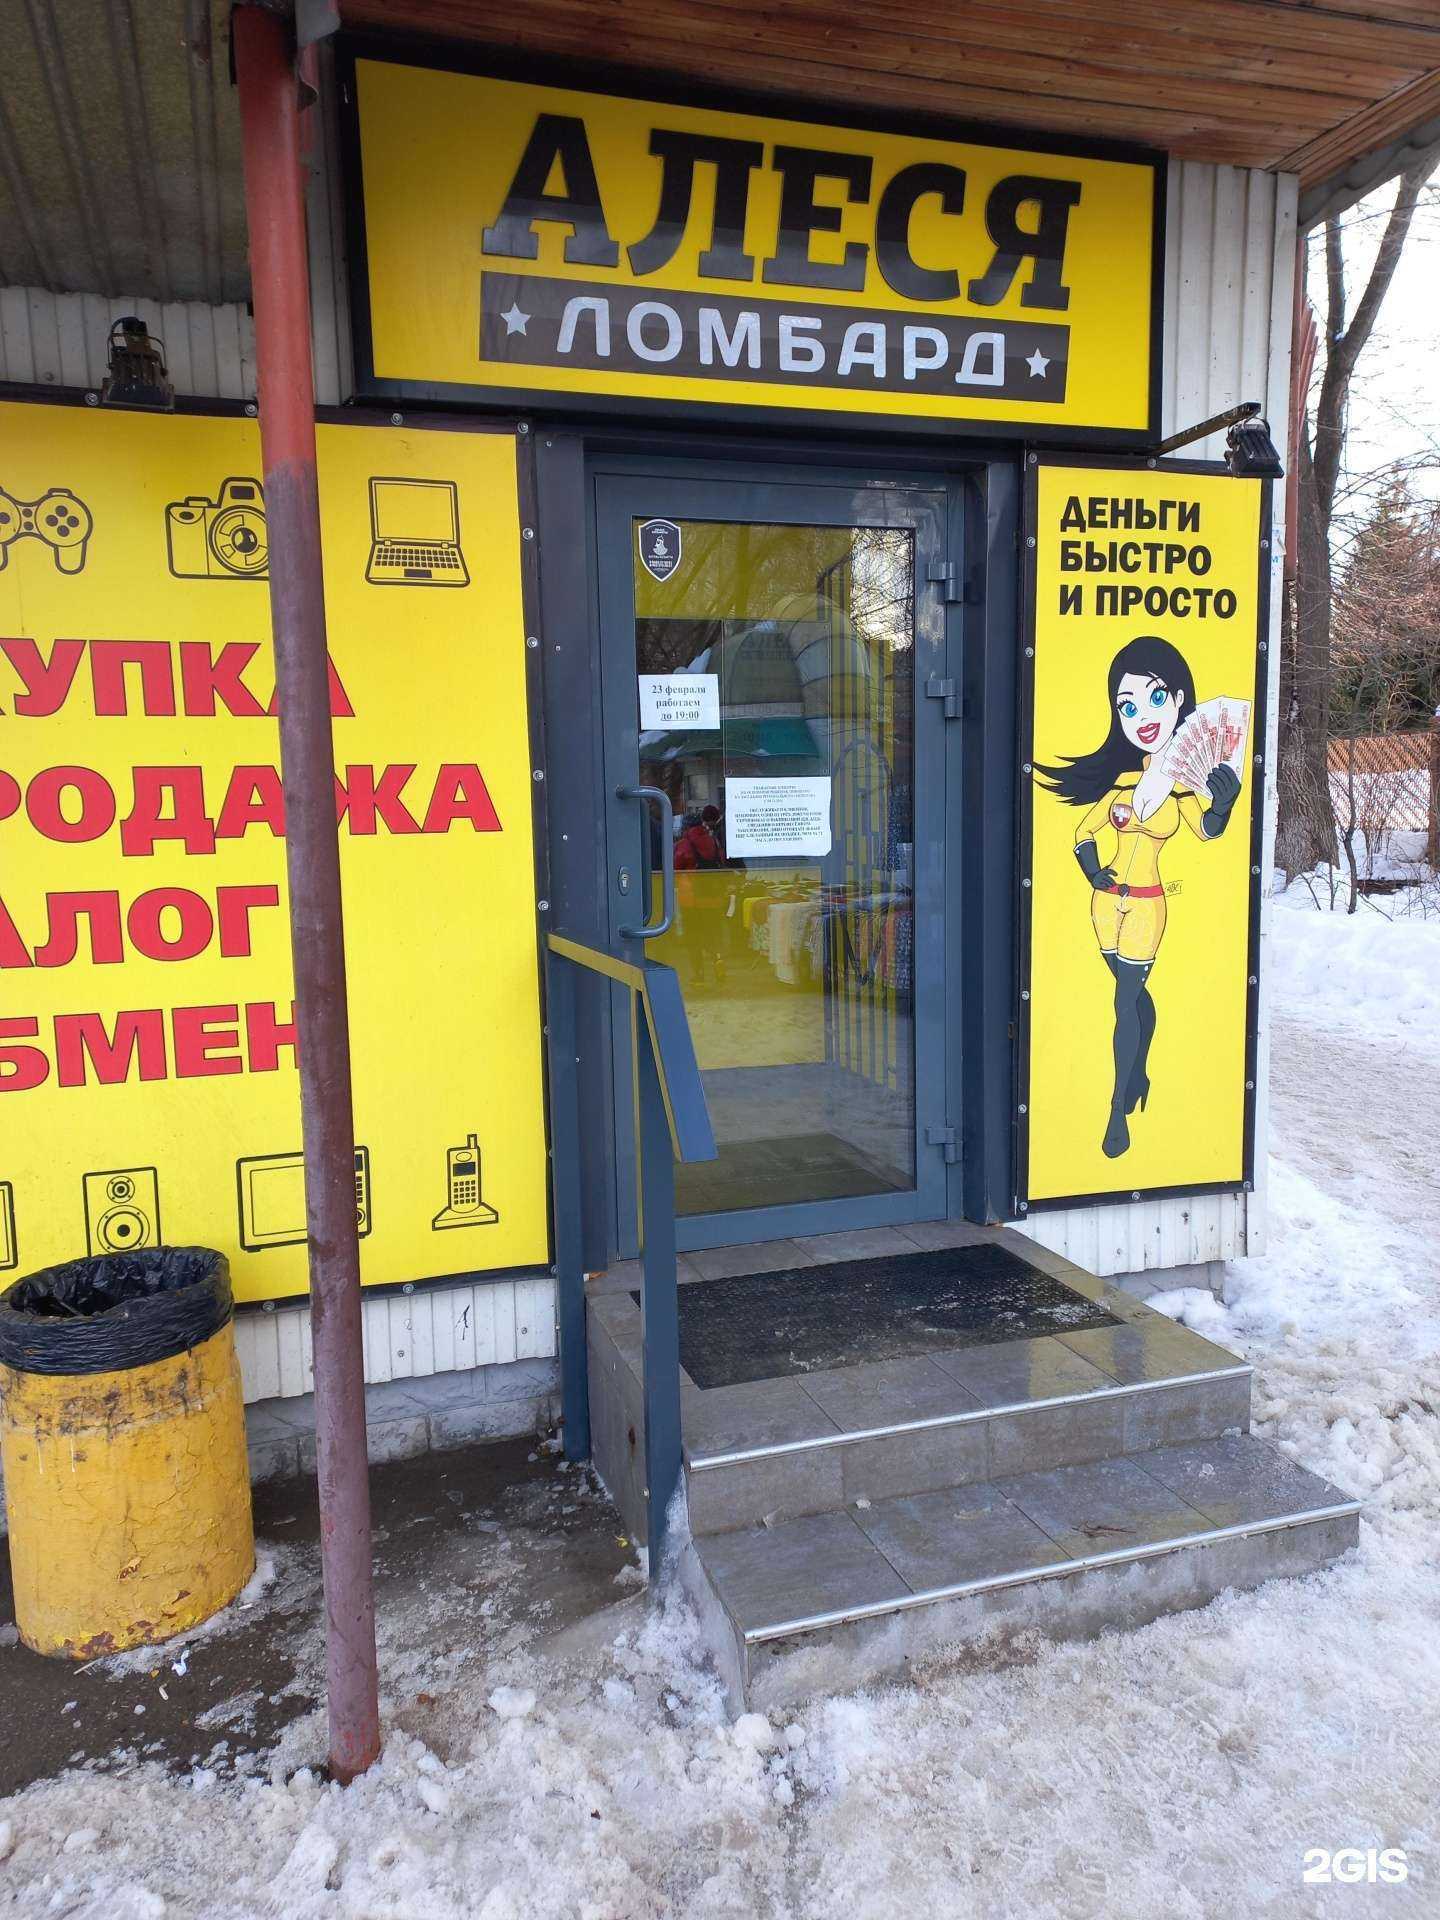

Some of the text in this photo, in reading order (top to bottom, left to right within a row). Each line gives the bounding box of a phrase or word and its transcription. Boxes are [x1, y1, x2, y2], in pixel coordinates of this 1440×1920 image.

[481, 112, 1082, 311] АЛЕСЯ
[556, 296, 1006, 387] ЛОМБАРД
[1060, 495, 1201, 533] ДЕНЬГИ
[1060, 540, 1212, 577] БЫСТРО
[1059, 584, 1238, 619] И ПРОСТО
[652, 684, 706, 696] 23 февраля
[656, 698, 701, 709] работаем
[675, 711, 699, 720] 19:00
